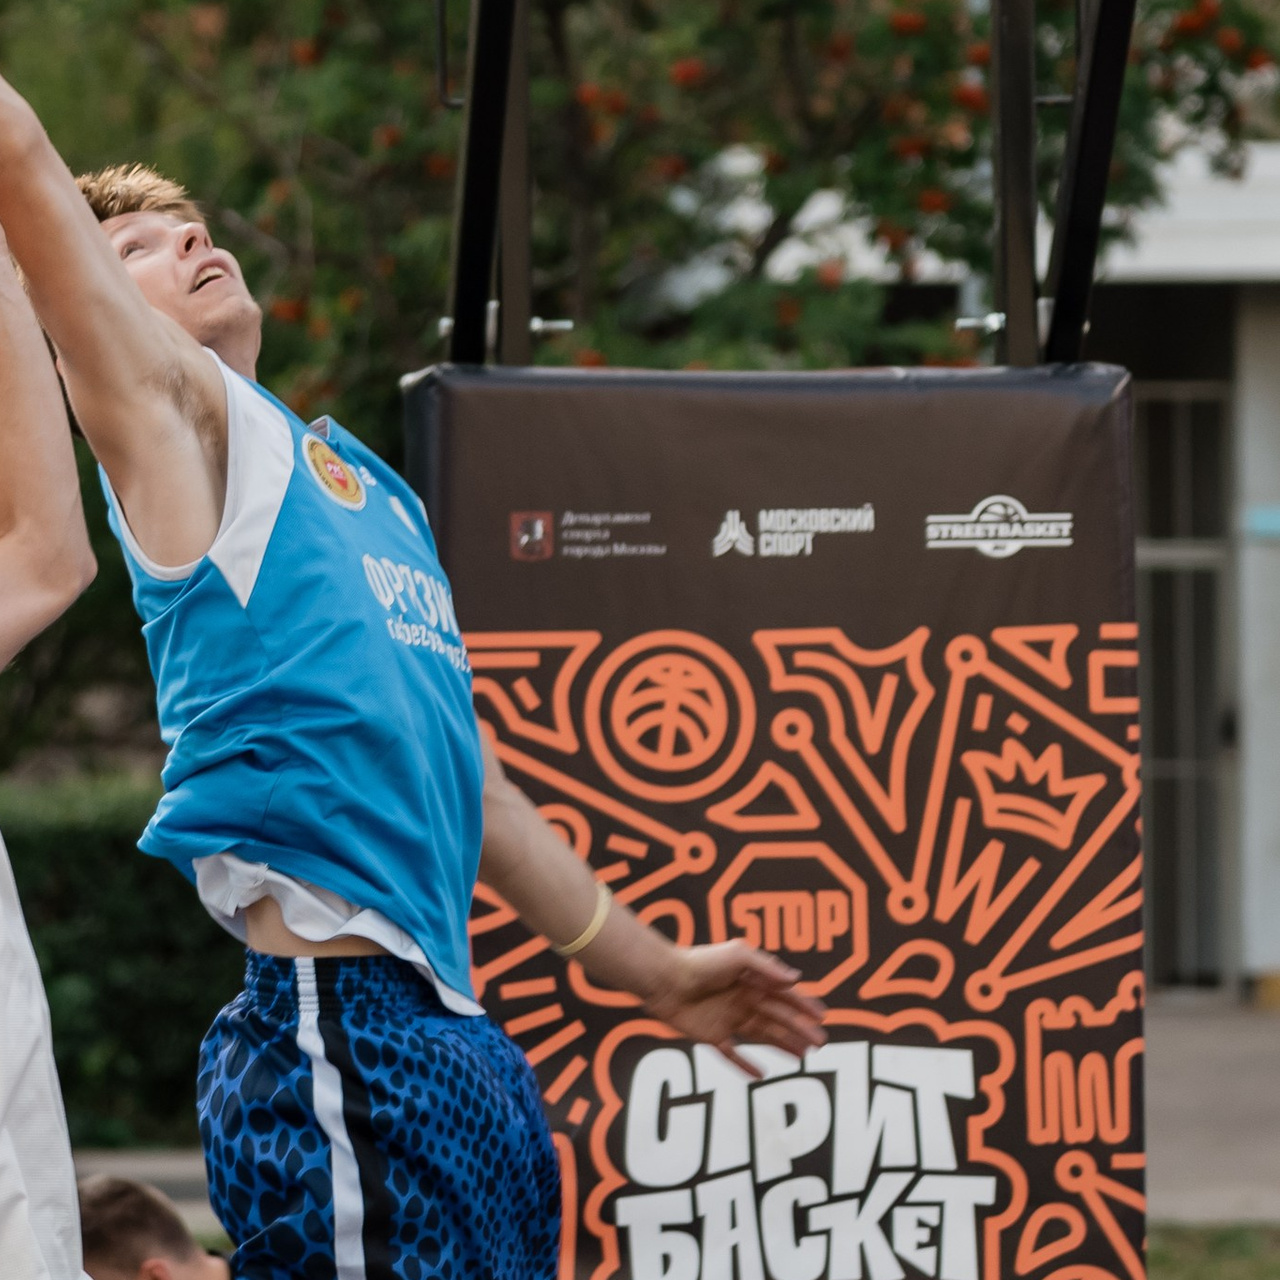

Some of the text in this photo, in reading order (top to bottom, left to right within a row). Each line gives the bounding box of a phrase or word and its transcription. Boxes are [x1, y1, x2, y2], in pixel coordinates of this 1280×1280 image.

[759, 503, 874, 532] МОСКОВСКИЙ
[926, 521, 1073, 539] STREETBASKET
[759, 532, 815, 556] СПОРТ
[731, 889, 849, 953] STOP
[624, 1041, 976, 1196] СТРИТ
